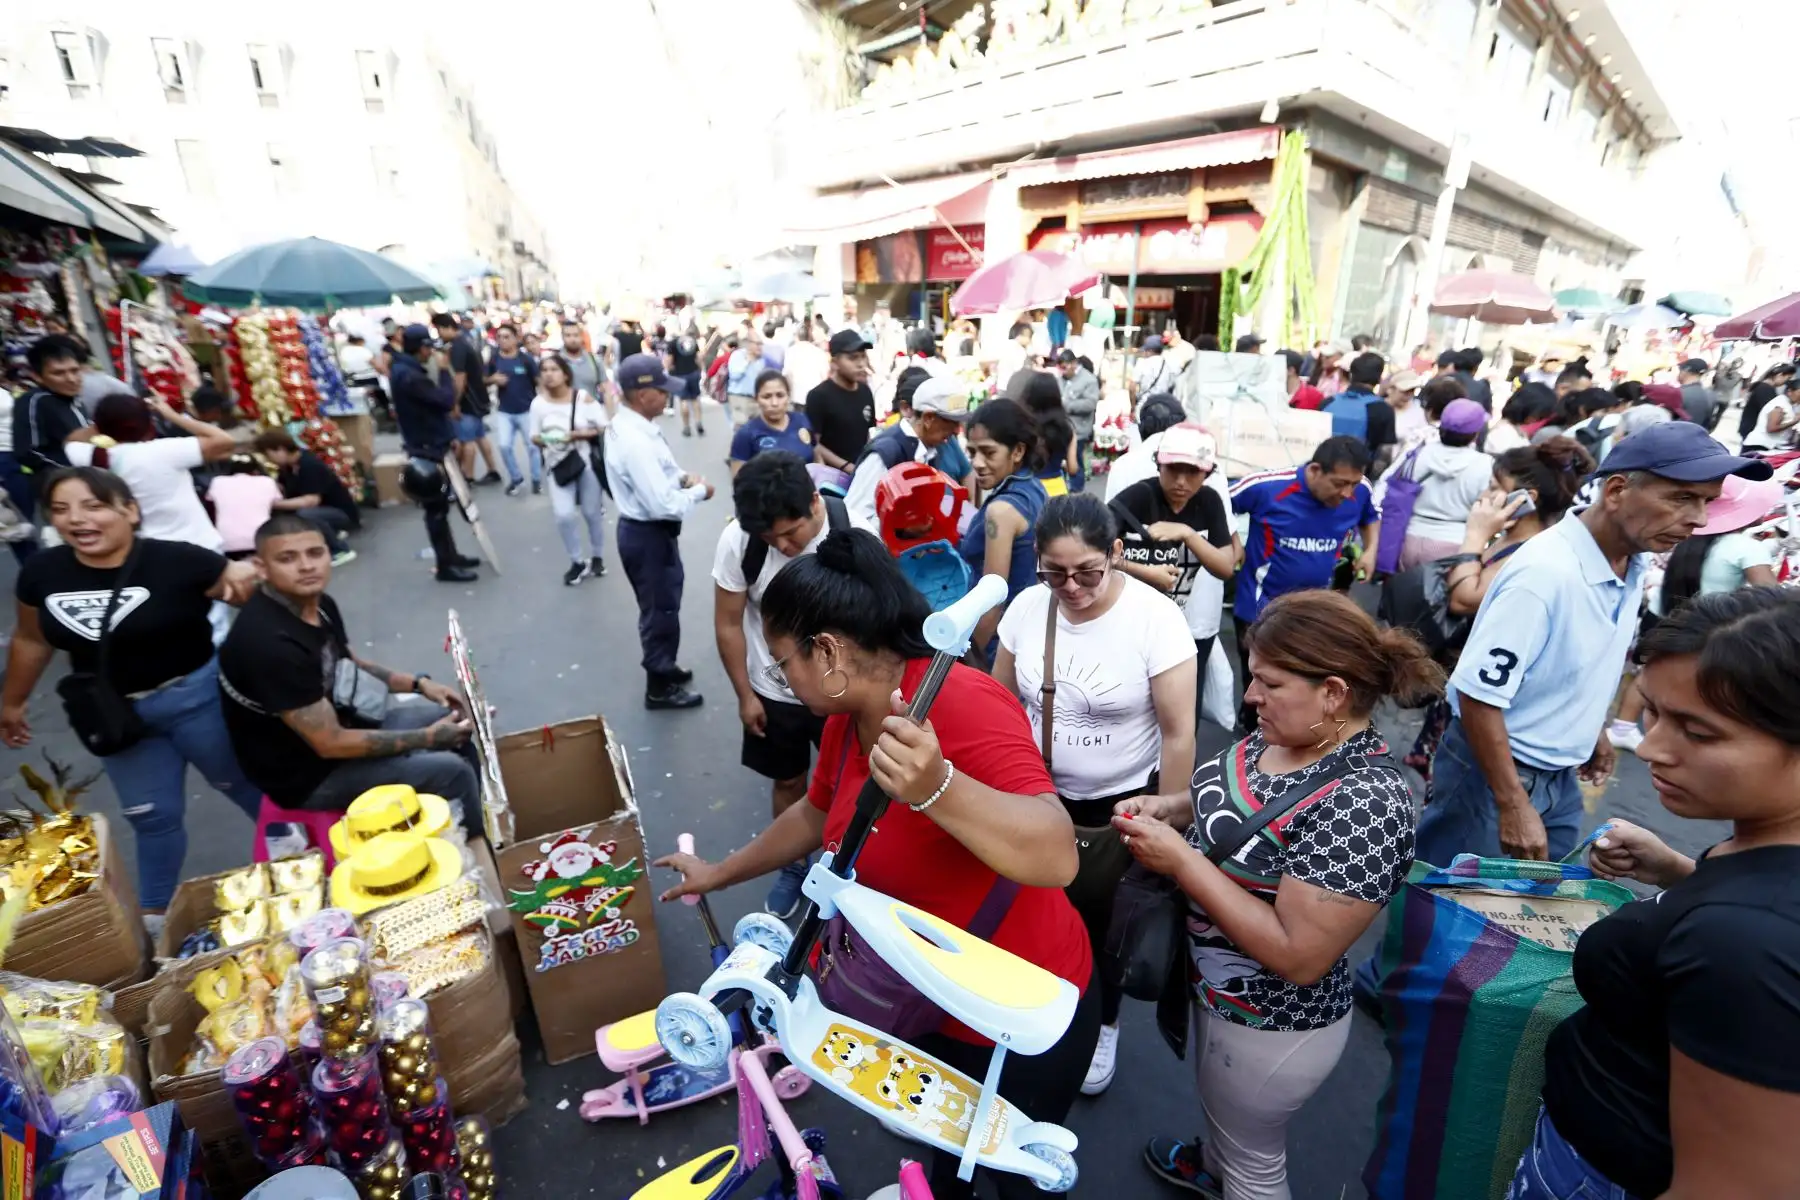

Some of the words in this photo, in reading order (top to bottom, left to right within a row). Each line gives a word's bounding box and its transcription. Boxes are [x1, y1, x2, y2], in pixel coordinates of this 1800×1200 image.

[1279, 537, 1338, 553] FRANCIA
[1123, 547, 1150, 561] APRI
[1478, 647, 1519, 688] 3
[1067, 734, 1112, 747] LIGHT
[1190, 749, 1265, 866] UCCI
